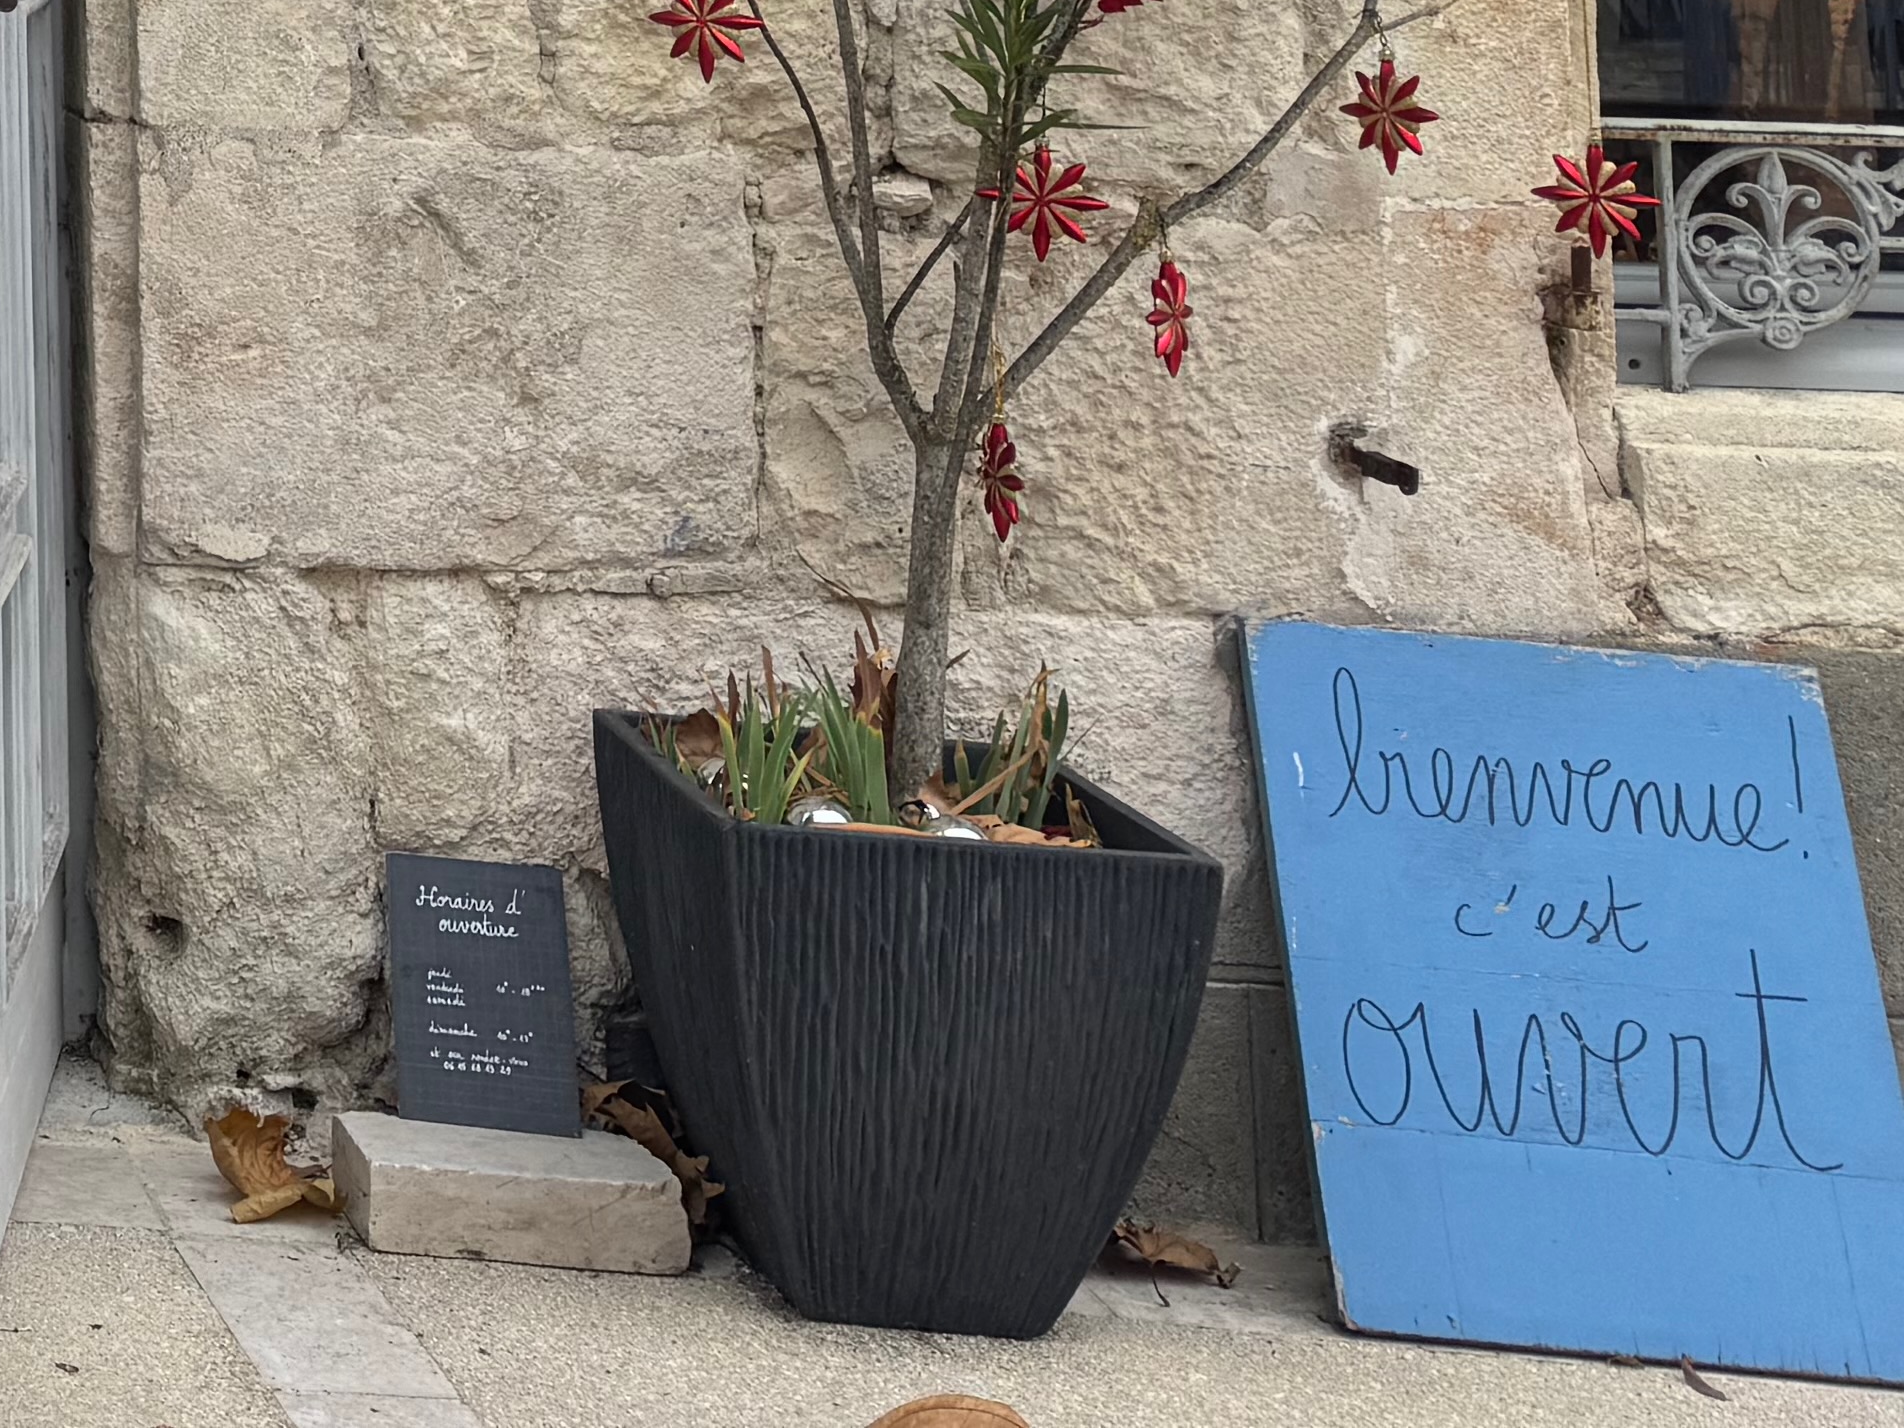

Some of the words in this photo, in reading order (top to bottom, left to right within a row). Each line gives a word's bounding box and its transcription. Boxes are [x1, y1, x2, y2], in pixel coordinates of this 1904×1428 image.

[416, 885, 494, 912] Horaires
[439, 913, 519, 936] ouverture
[1342, 946, 1844, 1175] ouvert
